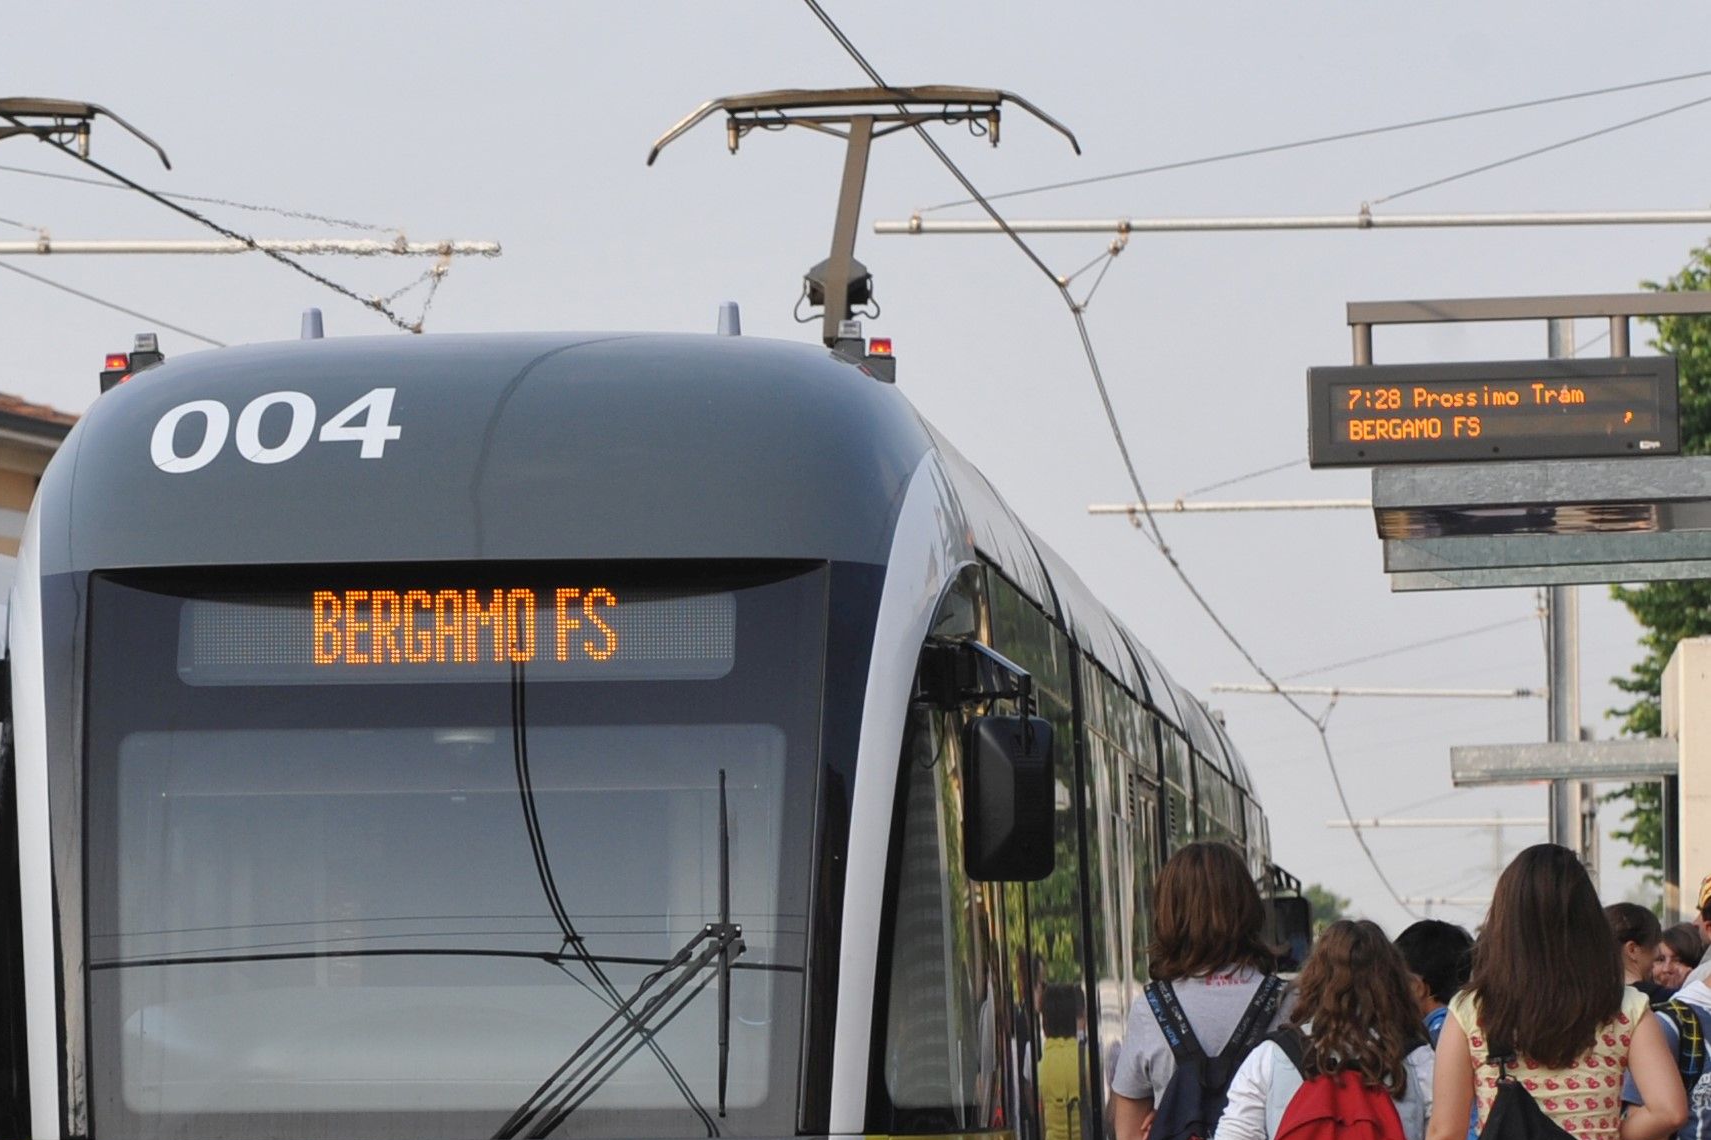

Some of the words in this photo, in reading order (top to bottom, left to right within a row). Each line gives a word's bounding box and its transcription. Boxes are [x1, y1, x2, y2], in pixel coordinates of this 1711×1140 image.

[1348, 388, 1402, 410] 7:28
[1413, 385, 1520, 408] Prossimo
[1531, 382, 1585, 405] Tram
[150, 387, 402, 474] 004
[1349, 417, 1442, 441] BERGAMO
[1453, 416, 1482, 439] FS
[313, 588, 536, 664] BERGAMO
[556, 586, 617, 661] FS
